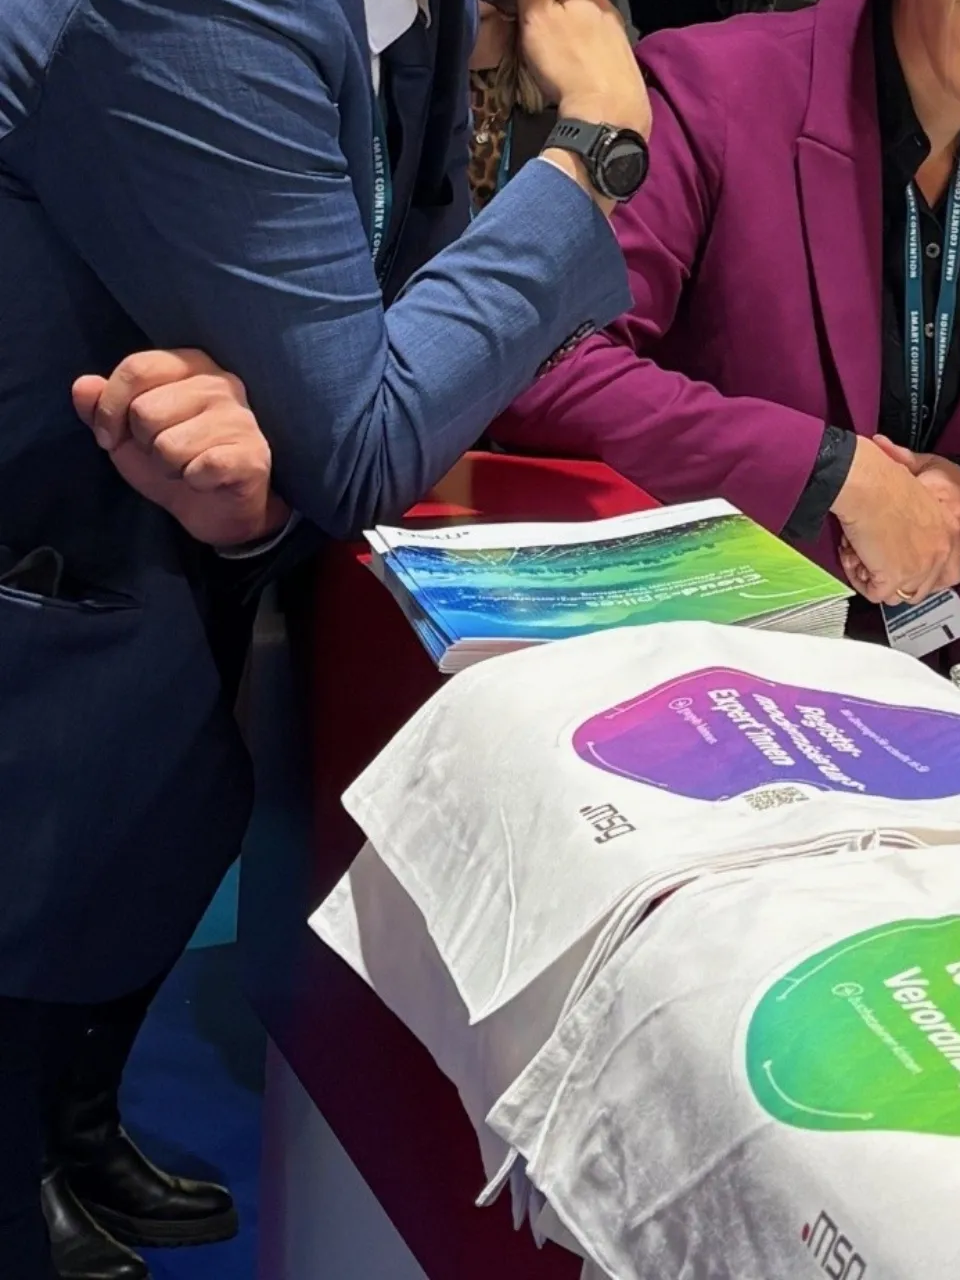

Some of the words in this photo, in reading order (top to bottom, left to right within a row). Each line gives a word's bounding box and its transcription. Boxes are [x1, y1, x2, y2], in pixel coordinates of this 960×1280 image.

[374, 177, 386, 230] COUNTRY
[909, 215, 918, 278] CONVENTION
[945, 250, 956, 282] SMART
[910, 310, 920, 343] SMART
[910, 346, 920, 390] COUNTRY
